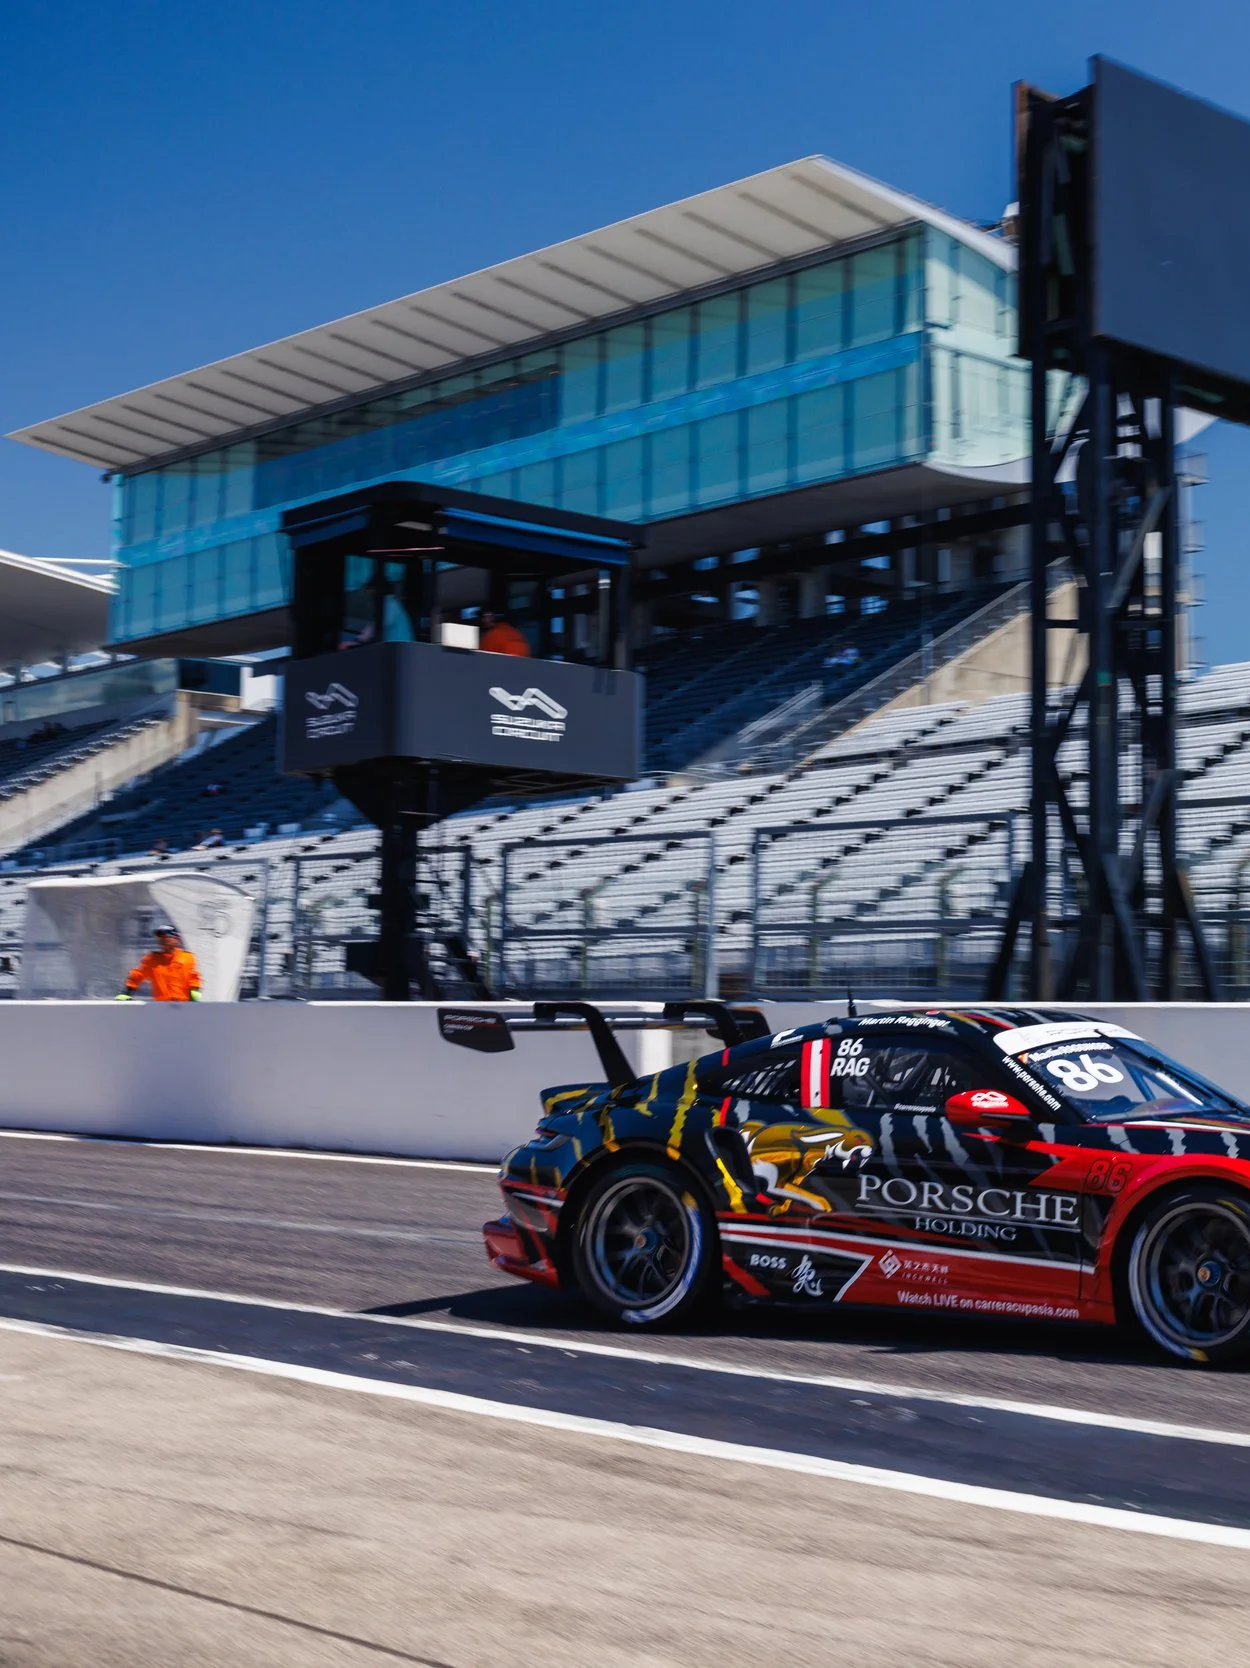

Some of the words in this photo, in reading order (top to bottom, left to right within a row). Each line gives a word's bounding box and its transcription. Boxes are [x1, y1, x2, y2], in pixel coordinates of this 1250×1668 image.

[490, 713, 566, 731] SUZUKA
[491, 726, 564, 742] CIRCUIT
[858, 1016, 895, 1026] Martin
[894, 1016, 951, 1028] Ragginger
[837, 1038, 864, 1057] 86
[830, 1057, 871, 1077] RAG
[1046, 1054, 1124, 1092] 86
[1002, 1055, 1062, 1111] www.porsche.com
[1086, 1159, 1133, 1193] 86
[857, 1173, 1081, 1225] PORSCHE
[914, 1217, 1017, 1241] HOLDING
[750, 1254, 787, 1270] BOSS
[897, 1290, 932, 1305] Watch
[933, 1293, 959, 1308] LIVE
[959, 1298, 974, 1308] on
[975, 1299, 1080, 1318] carreracupasia.com
